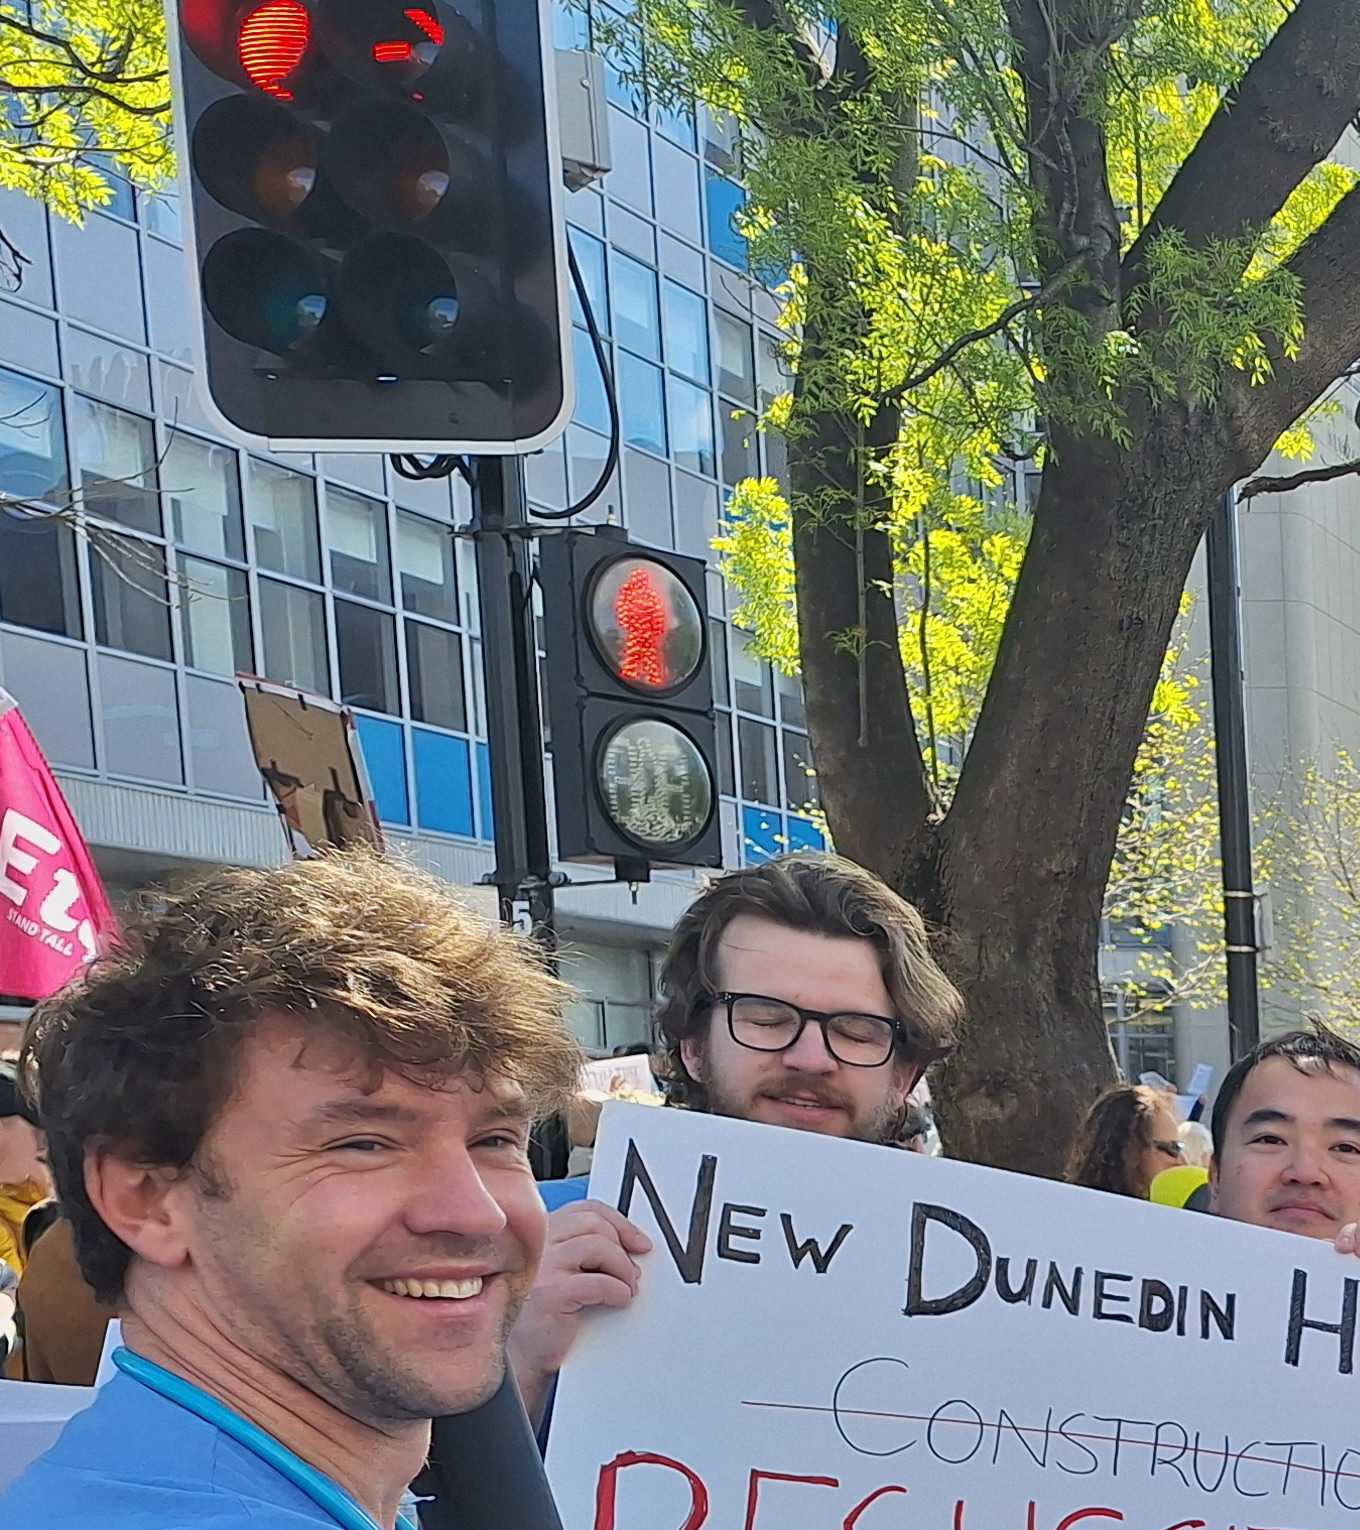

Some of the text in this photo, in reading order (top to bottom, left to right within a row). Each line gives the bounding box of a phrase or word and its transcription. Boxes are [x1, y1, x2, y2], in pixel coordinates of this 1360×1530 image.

[8, 908, 74, 957] STAND TALL
[615, 1136, 855, 1286] NEW
[902, 1201, 1237, 1342] DUNEDIN
